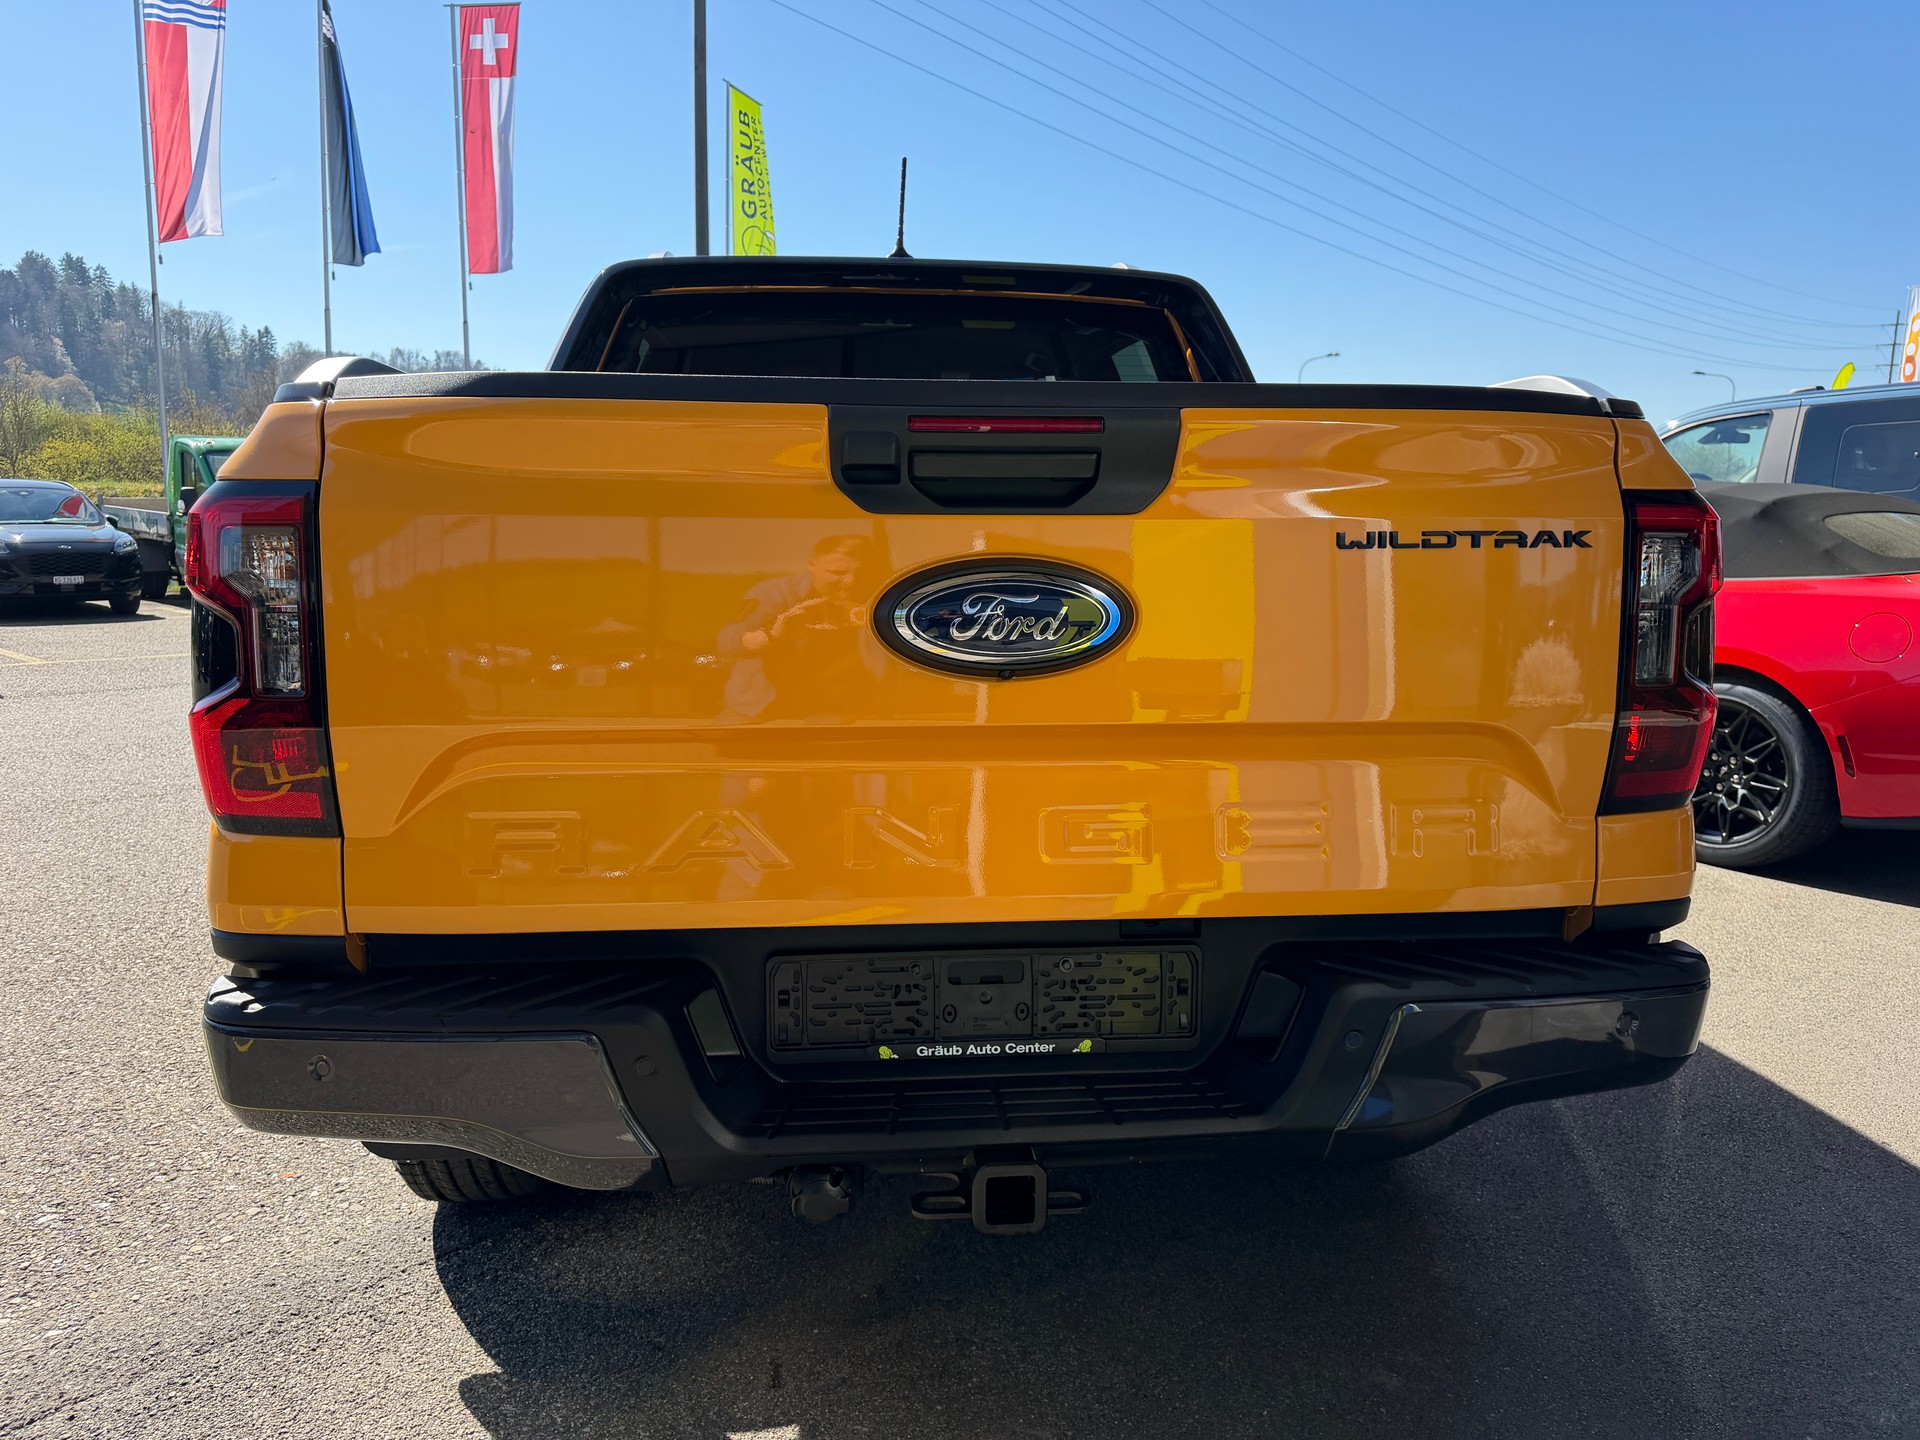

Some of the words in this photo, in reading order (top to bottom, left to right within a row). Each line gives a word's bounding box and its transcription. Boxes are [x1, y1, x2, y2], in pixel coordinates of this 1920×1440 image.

[736, 109, 758, 219] GRÄUB
[750, 116, 768, 220] AUTOCENTER
[1336, 530, 1593, 550] WILDTRAK
[950, 592, 1068, 641] Ford
[464, 800, 1501, 878] RANGER
[916, 1044, 963, 1057] Gräub
[966, 1043, 1001, 1055] Auto
[1005, 1042, 1056, 1054] Center
